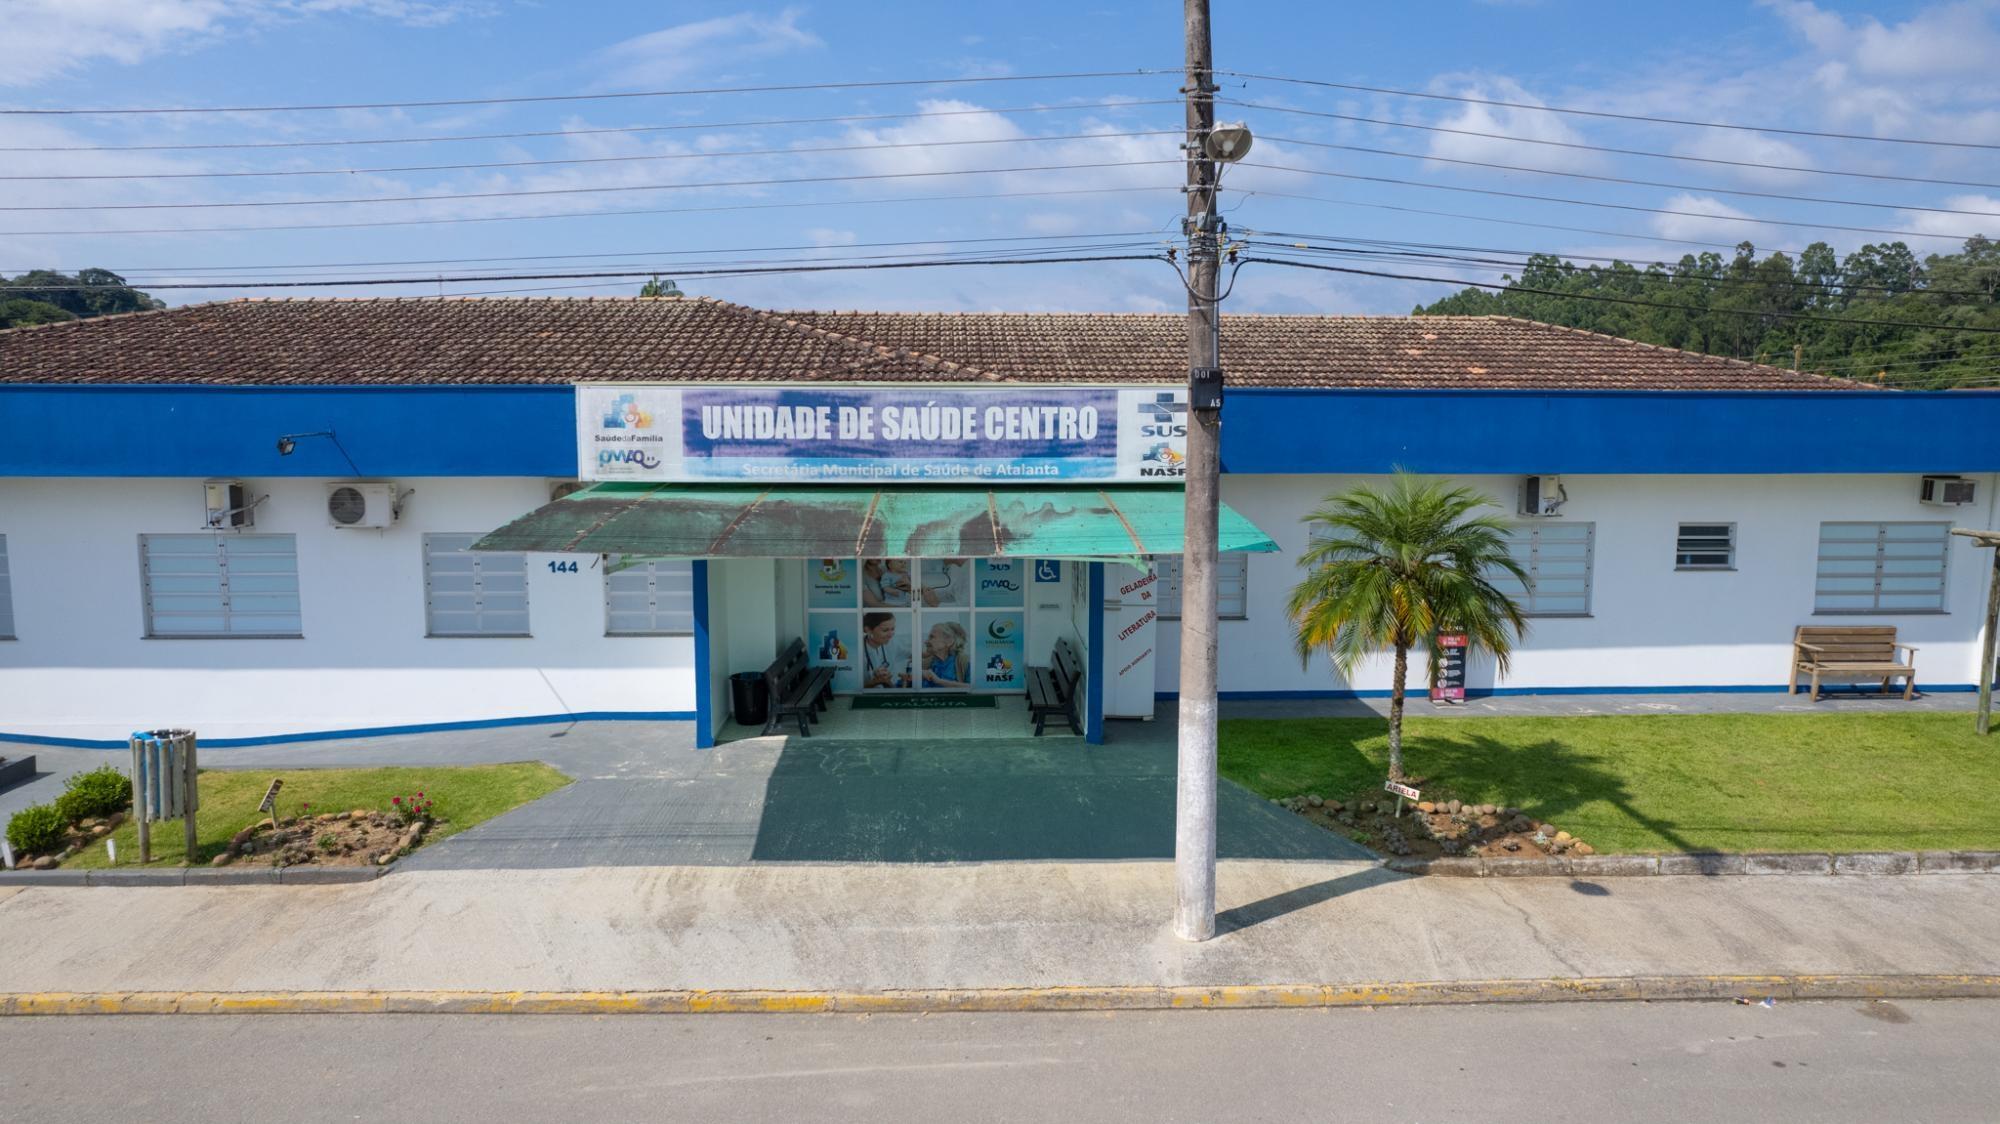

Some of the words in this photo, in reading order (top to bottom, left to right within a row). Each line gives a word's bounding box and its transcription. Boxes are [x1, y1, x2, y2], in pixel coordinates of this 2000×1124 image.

[702, 405, 831, 440] UNIDADE
[839, 406, 874, 440] DE
[881, 401, 977, 441] SAÚDE
[984, 405, 1098, 440] CENTRO
[1141, 425, 1188, 438] SUS
[823, 463, 897, 479] Municipal
[902, 463, 919, 476] de
[924, 463, 970, 476] Saúde
[974, 463, 992, 476] de
[996, 463, 1059, 476] Atalanta
[1140, 467, 1187, 477] NASF
[547, 560, 579, 574] 144
[1120, 573, 1158, 596] GELADEIRA
[1140, 590, 1152, 601] DA
[1118, 609, 1156, 641] LITERATURA
[1386, 783, 1418, 799] ARIELA
